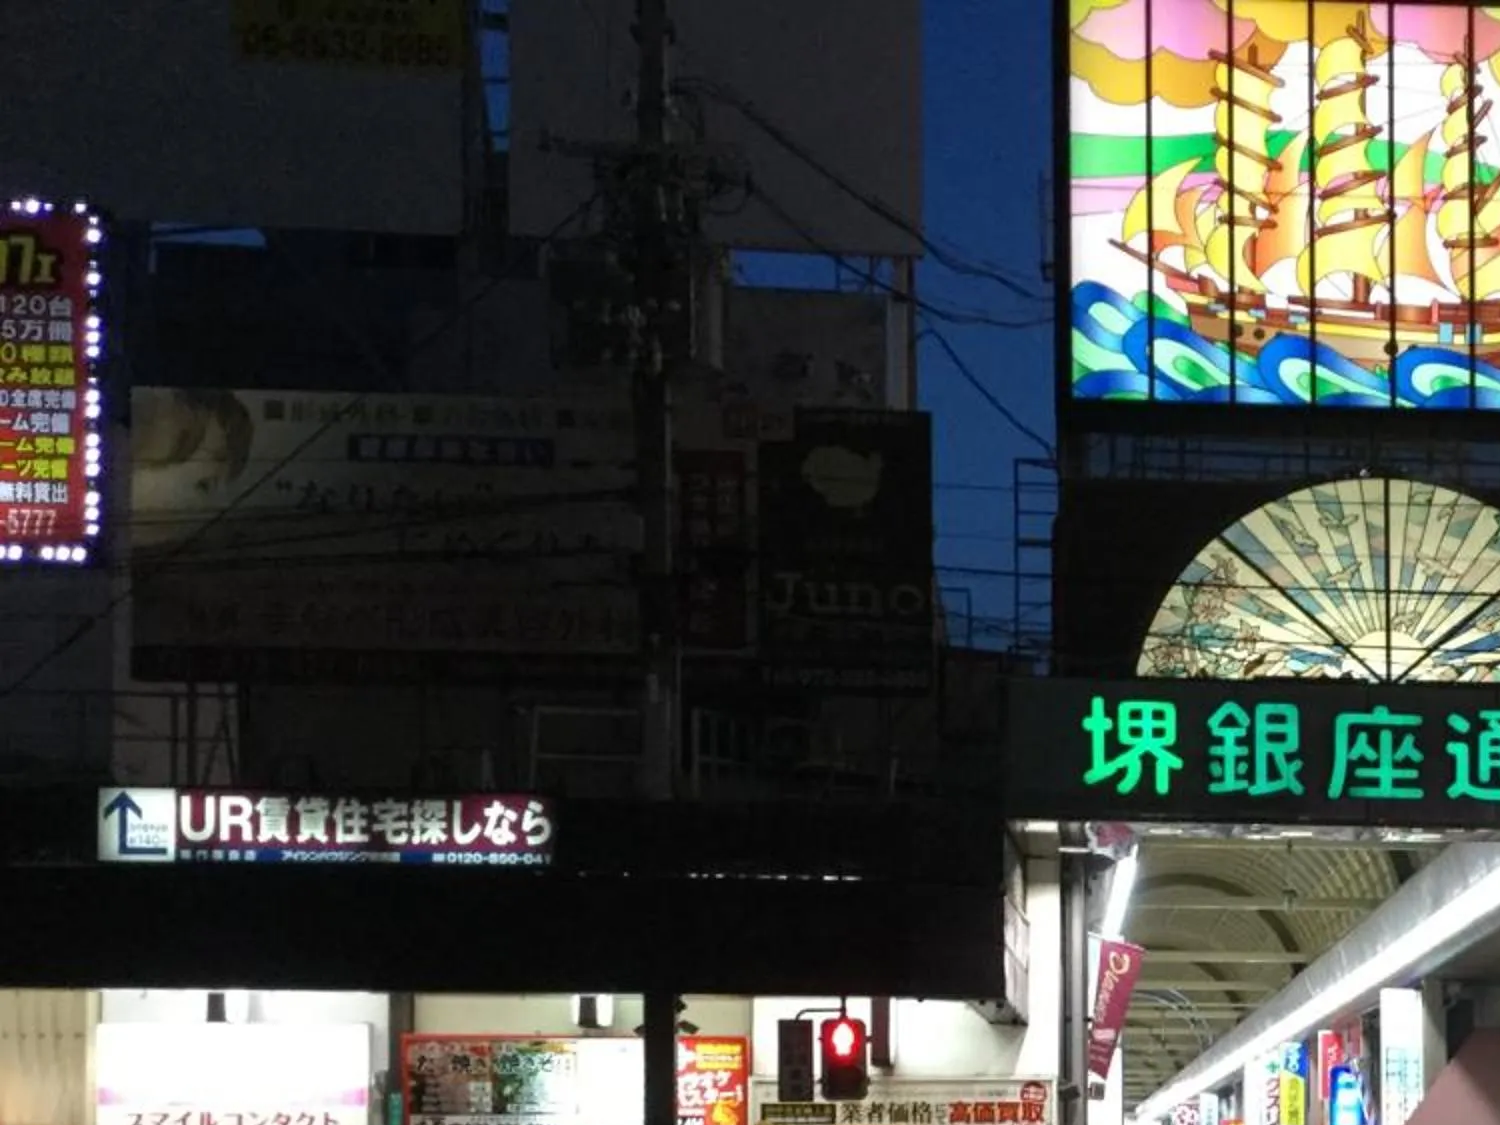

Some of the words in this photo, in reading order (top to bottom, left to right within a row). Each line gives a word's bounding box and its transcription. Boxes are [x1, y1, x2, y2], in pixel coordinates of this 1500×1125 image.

[180, 795, 551, 846] UR賃貸住宅探しなら
